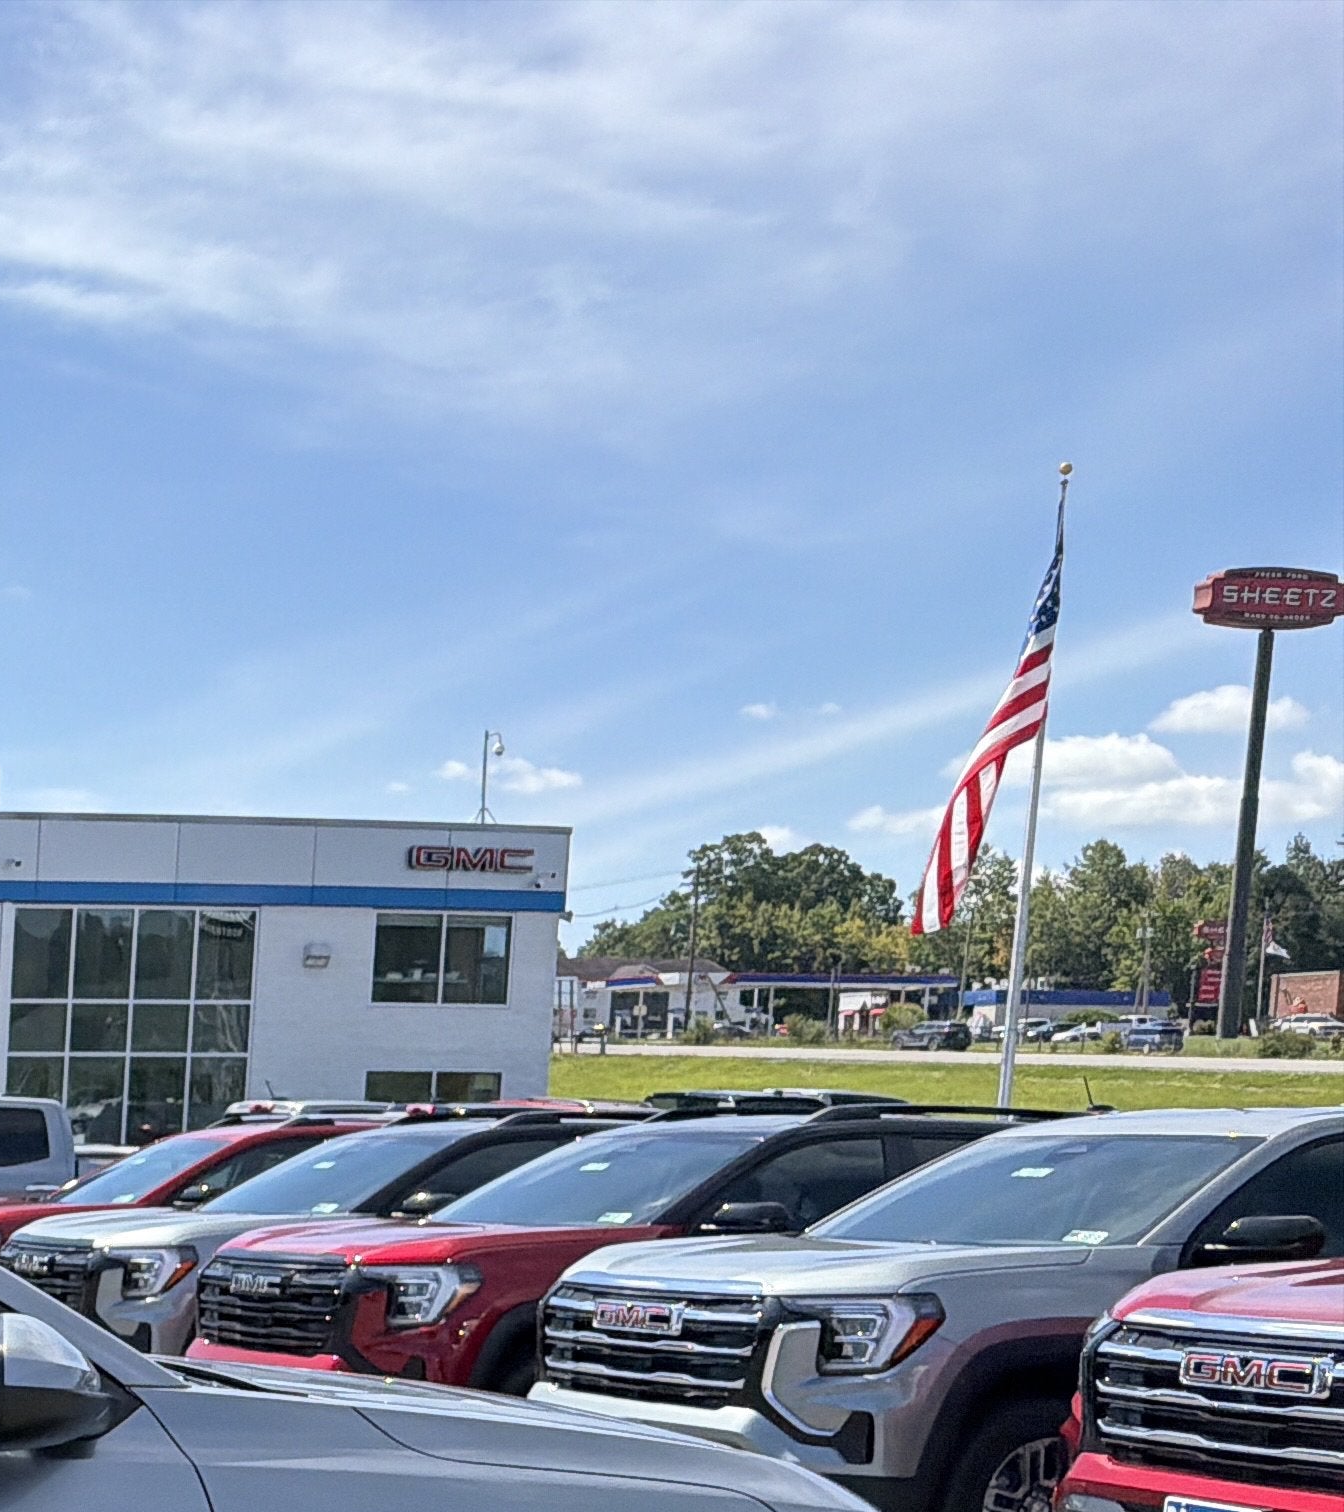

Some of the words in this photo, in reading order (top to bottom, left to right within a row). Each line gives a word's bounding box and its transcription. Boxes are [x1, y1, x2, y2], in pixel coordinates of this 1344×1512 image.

[1222, 585, 1337, 608] SHEETZ
[408, 845, 534, 873] GMC
[596, 1303, 670, 1331] GMC
[1186, 1353, 1312, 1393] GMC
